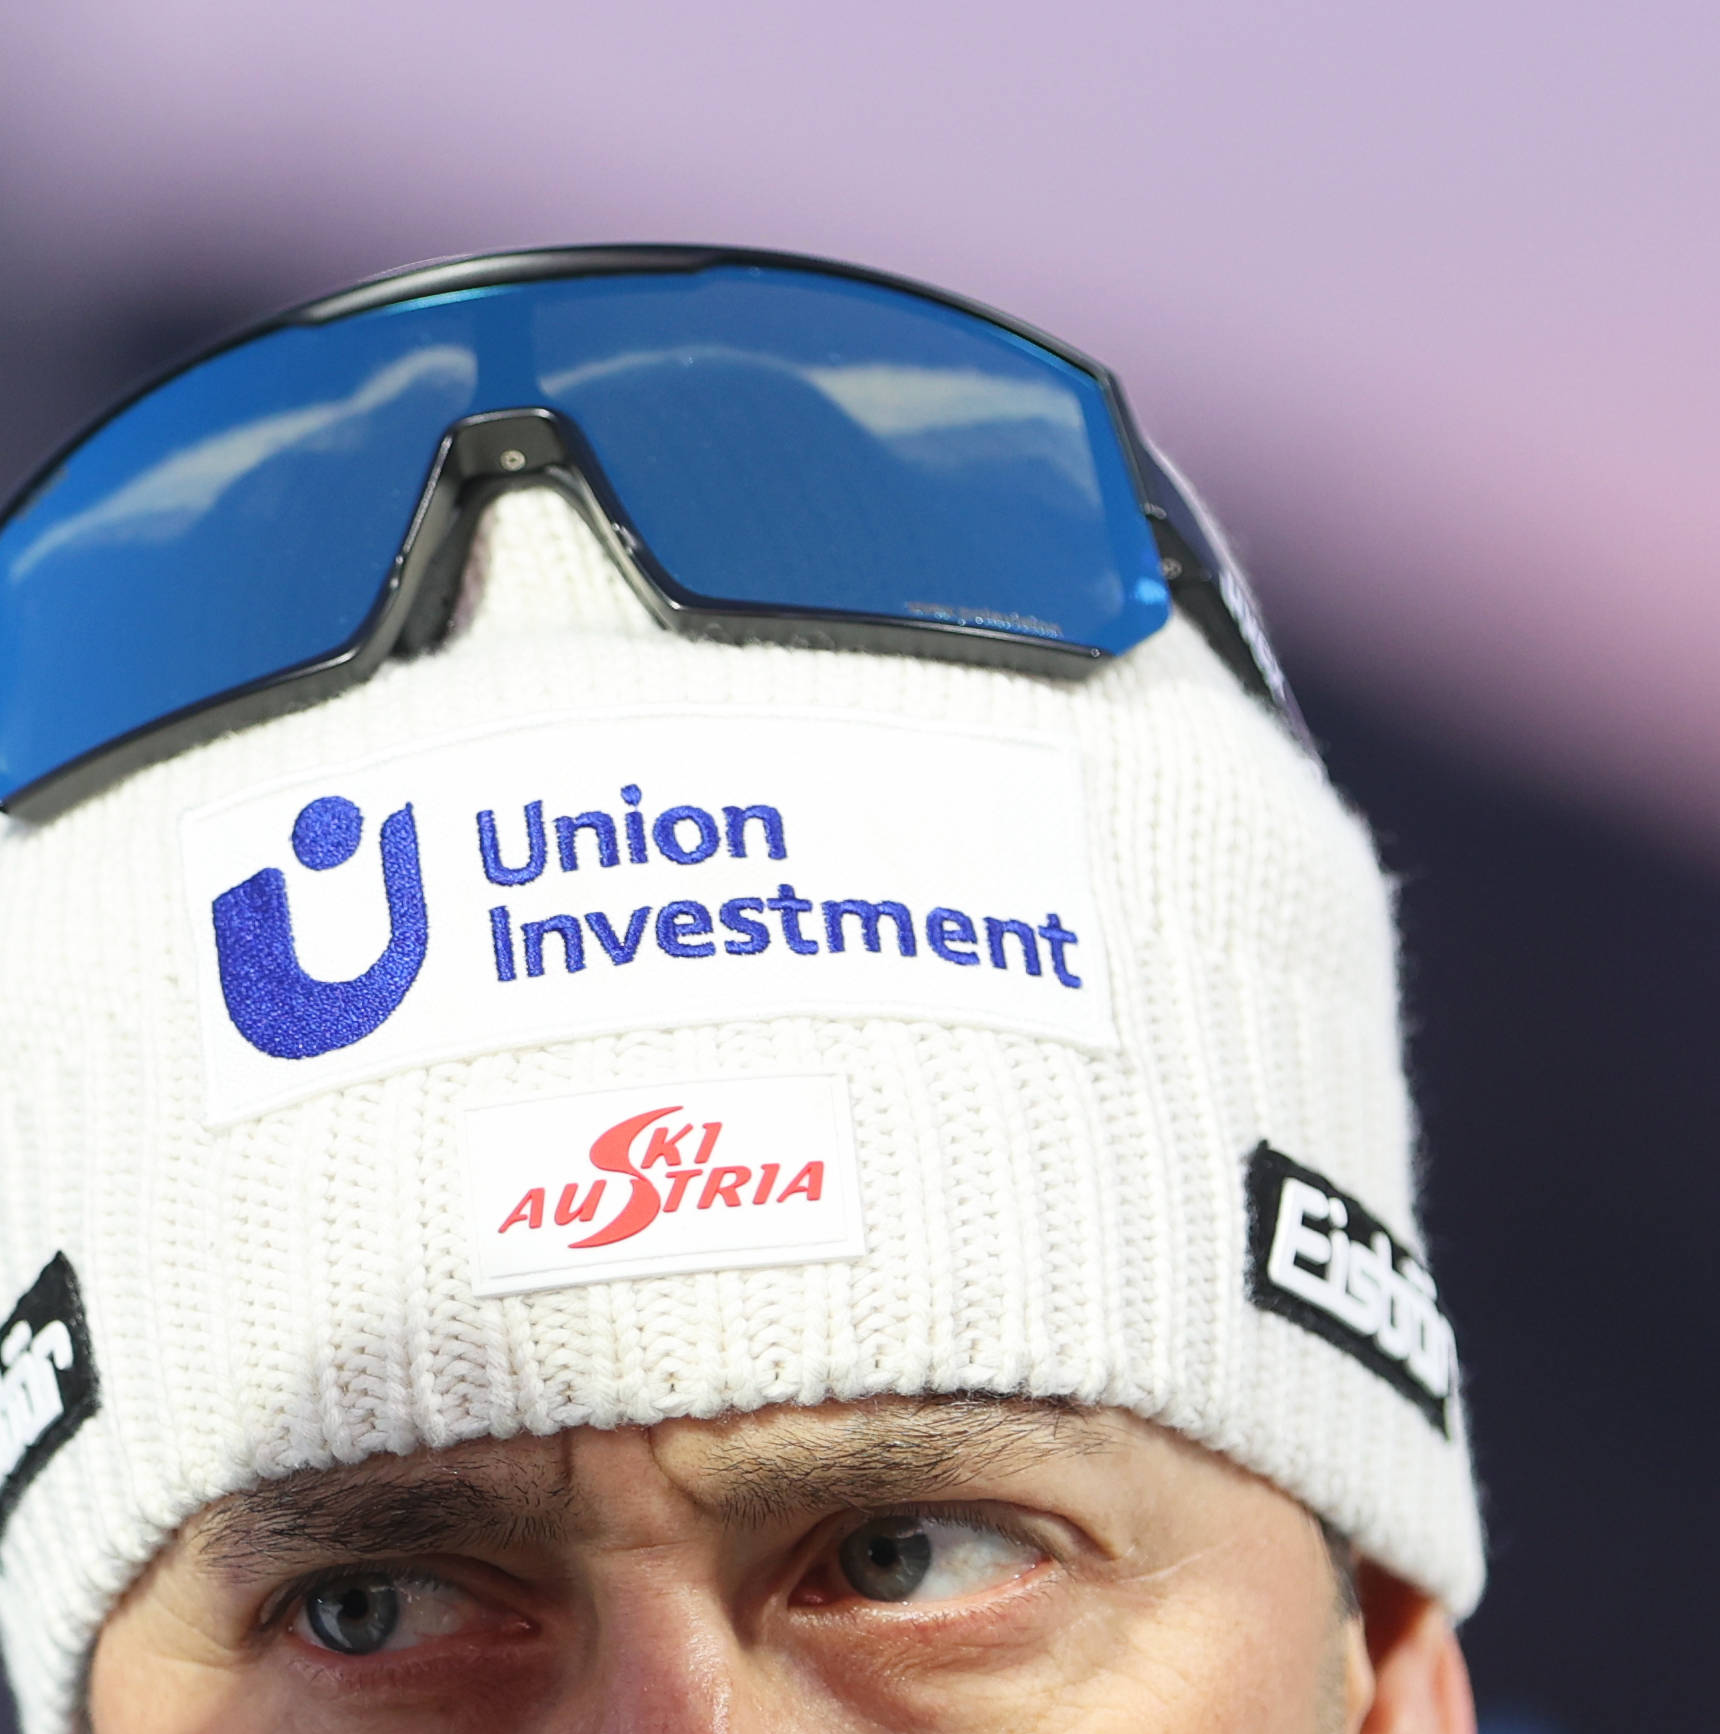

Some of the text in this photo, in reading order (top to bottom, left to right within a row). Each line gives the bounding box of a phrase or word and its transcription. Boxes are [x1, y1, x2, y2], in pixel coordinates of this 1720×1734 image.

[476, 783, 787, 886] Union
[489, 884, 1084, 989] Investment
[589, 1106, 723, 1188] SKI
[498, 1158, 825, 1248] AUSTRIA
[1267, 1176, 1458, 1398] Eisbä
